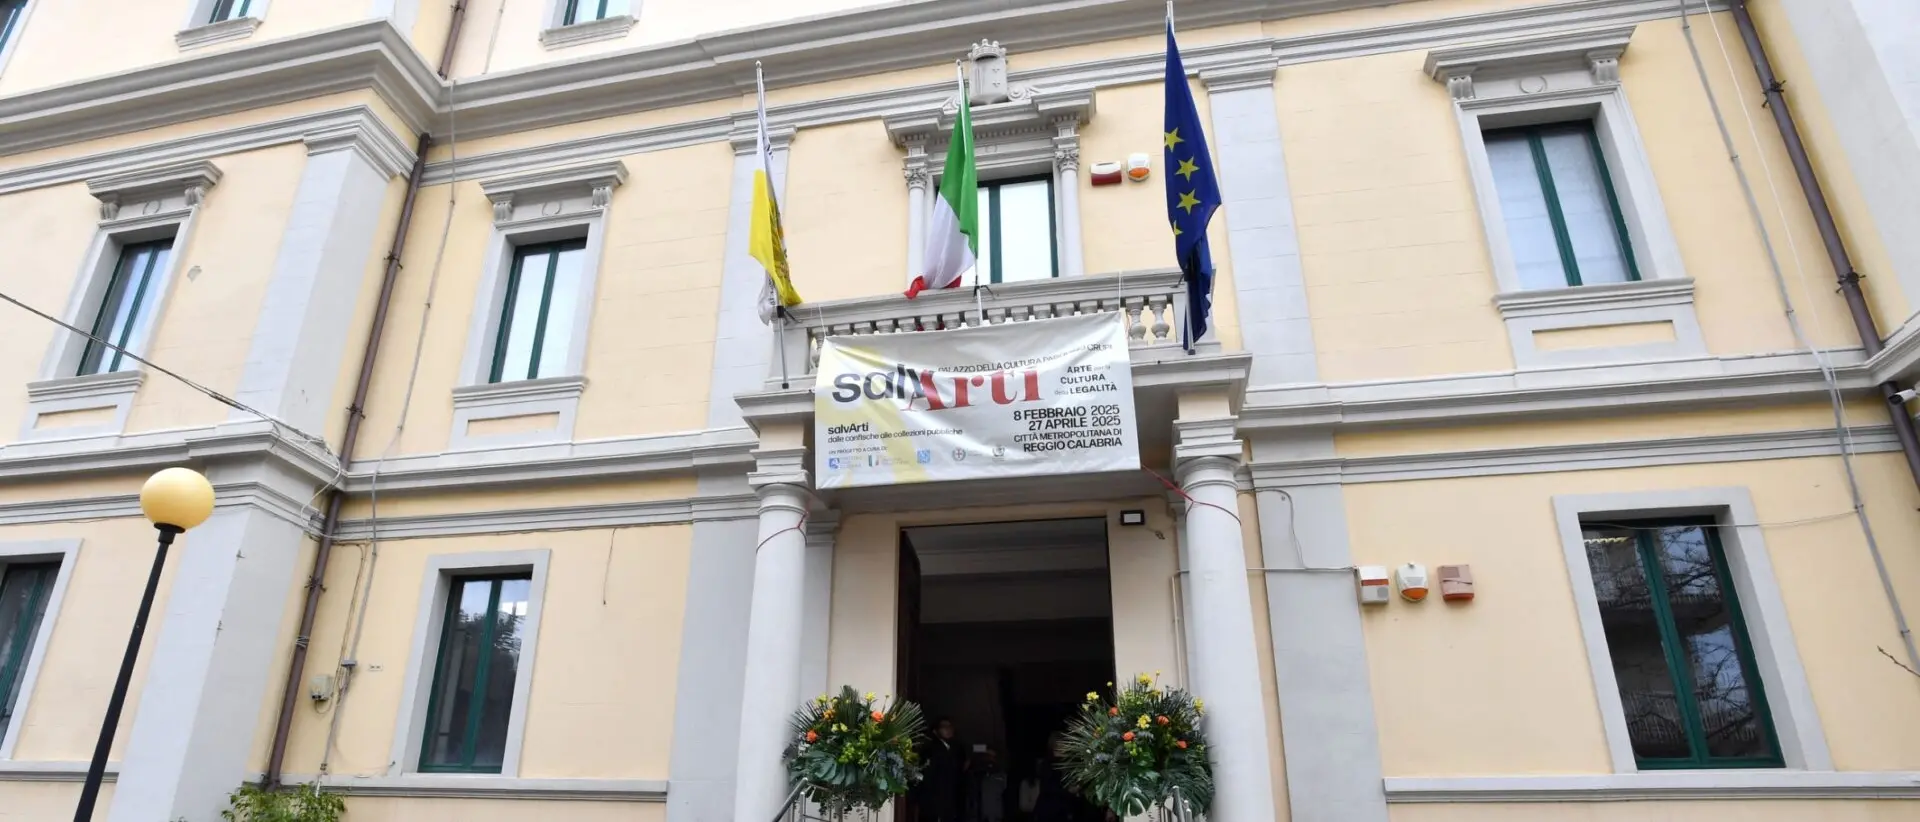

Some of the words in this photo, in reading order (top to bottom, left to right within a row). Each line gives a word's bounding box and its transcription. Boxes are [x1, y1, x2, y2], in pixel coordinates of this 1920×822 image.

[976, 362, 1003, 372] DELLA
[1003, 358, 1043, 370] CULTURA
[1067, 365, 1093, 374] ARTE
[1060, 373, 1106, 385] CULTURA
[1070, 381, 1118, 395] LEGALITÀ
[1013, 410, 1022, 421] 8
[1023, 405, 1087, 420] FEBBRAIO
[1090, 404, 1120, 416] 2025
[827, 422, 869, 435] salvArti
[1028, 420, 1042, 431] 27
[1045, 417, 1088, 430] APRILE
[1092, 415, 1121, 427] 2025
[827, 435, 845, 443] dalle
[845, 433, 879, 442] confische
[879, 431, 893, 439] alle
[893, 429, 926, 437] collezioni
[1013, 431, 1039, 442] CITTÀ
[1039, 428, 1113, 441] METROPOLITANA
[1113, 428, 1122, 436] DI
[1023, 440, 1066, 452] REGGIO
[1066, 437, 1123, 449] CALABRIA
